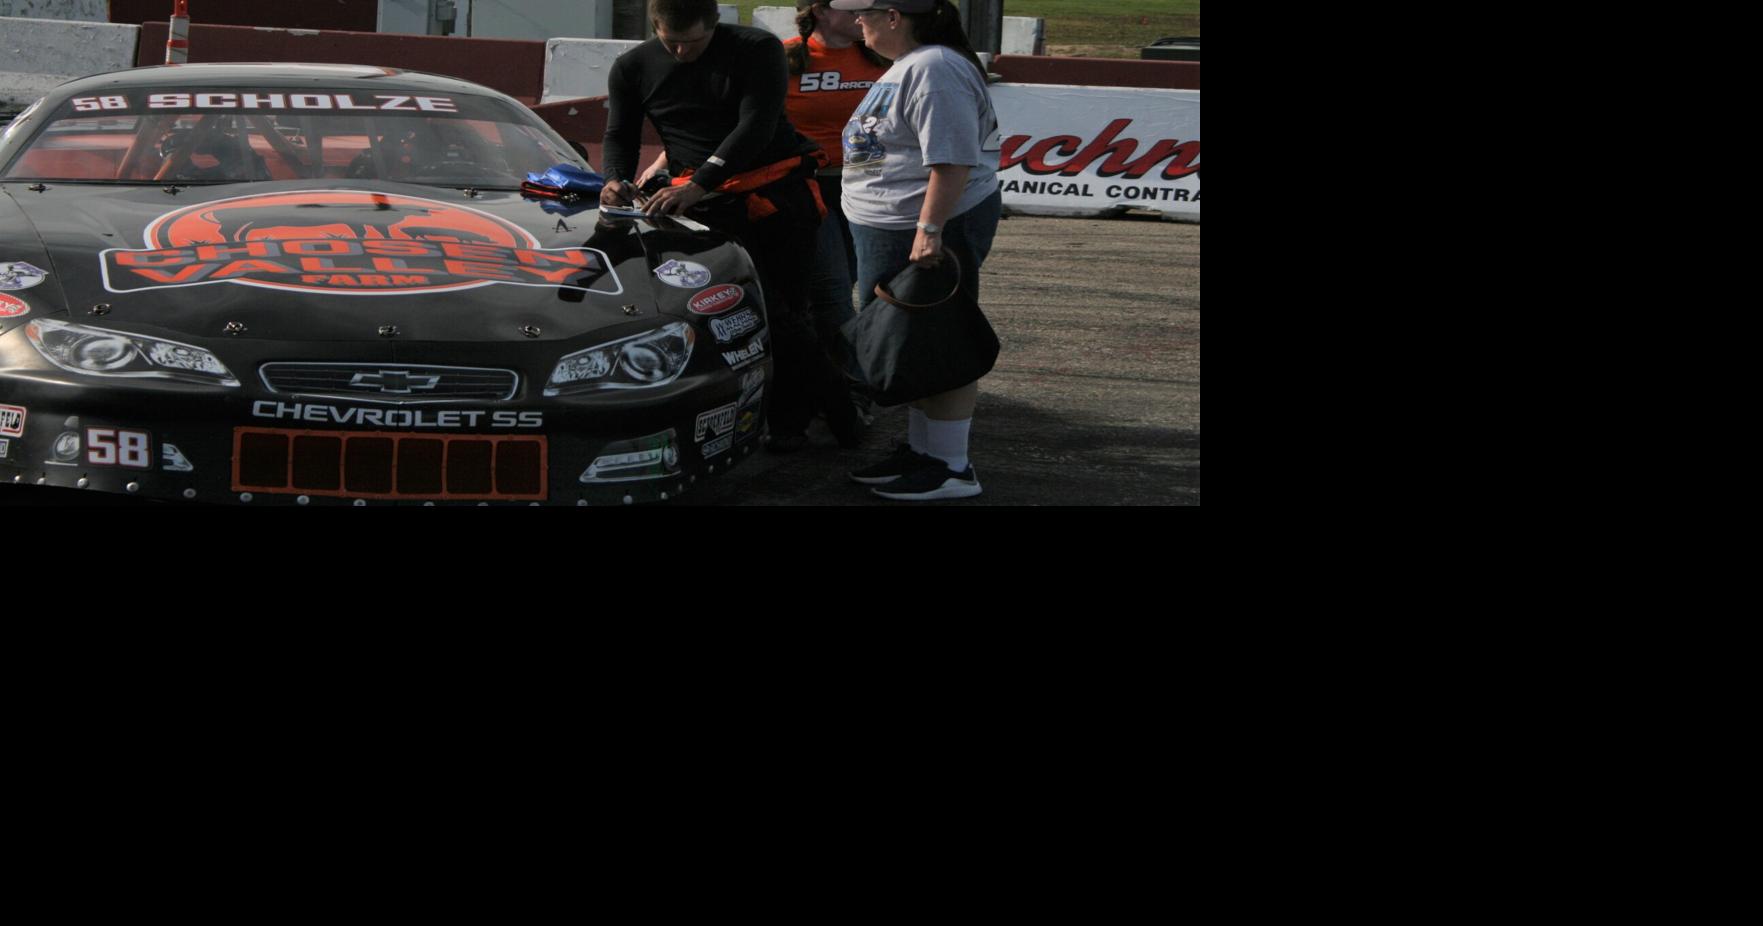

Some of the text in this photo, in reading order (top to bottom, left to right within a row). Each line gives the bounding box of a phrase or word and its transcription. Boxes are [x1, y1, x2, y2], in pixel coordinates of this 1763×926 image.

[799, 71, 840, 92] 58
[71, 92, 459, 114] 58 SCHOLZE
[998, 179, 1094, 197] ANICAL
[114, 240, 598, 267] CHOSEN
[130, 257, 592, 283] VALLEY
[302, 274, 428, 286] FARM
[692, 288, 731, 308] KIRKEY
[721, 338, 764, 365] WHELEN
[252, 400, 543, 427] CHEVROLET SS
[87, 427, 149, 468] 58
